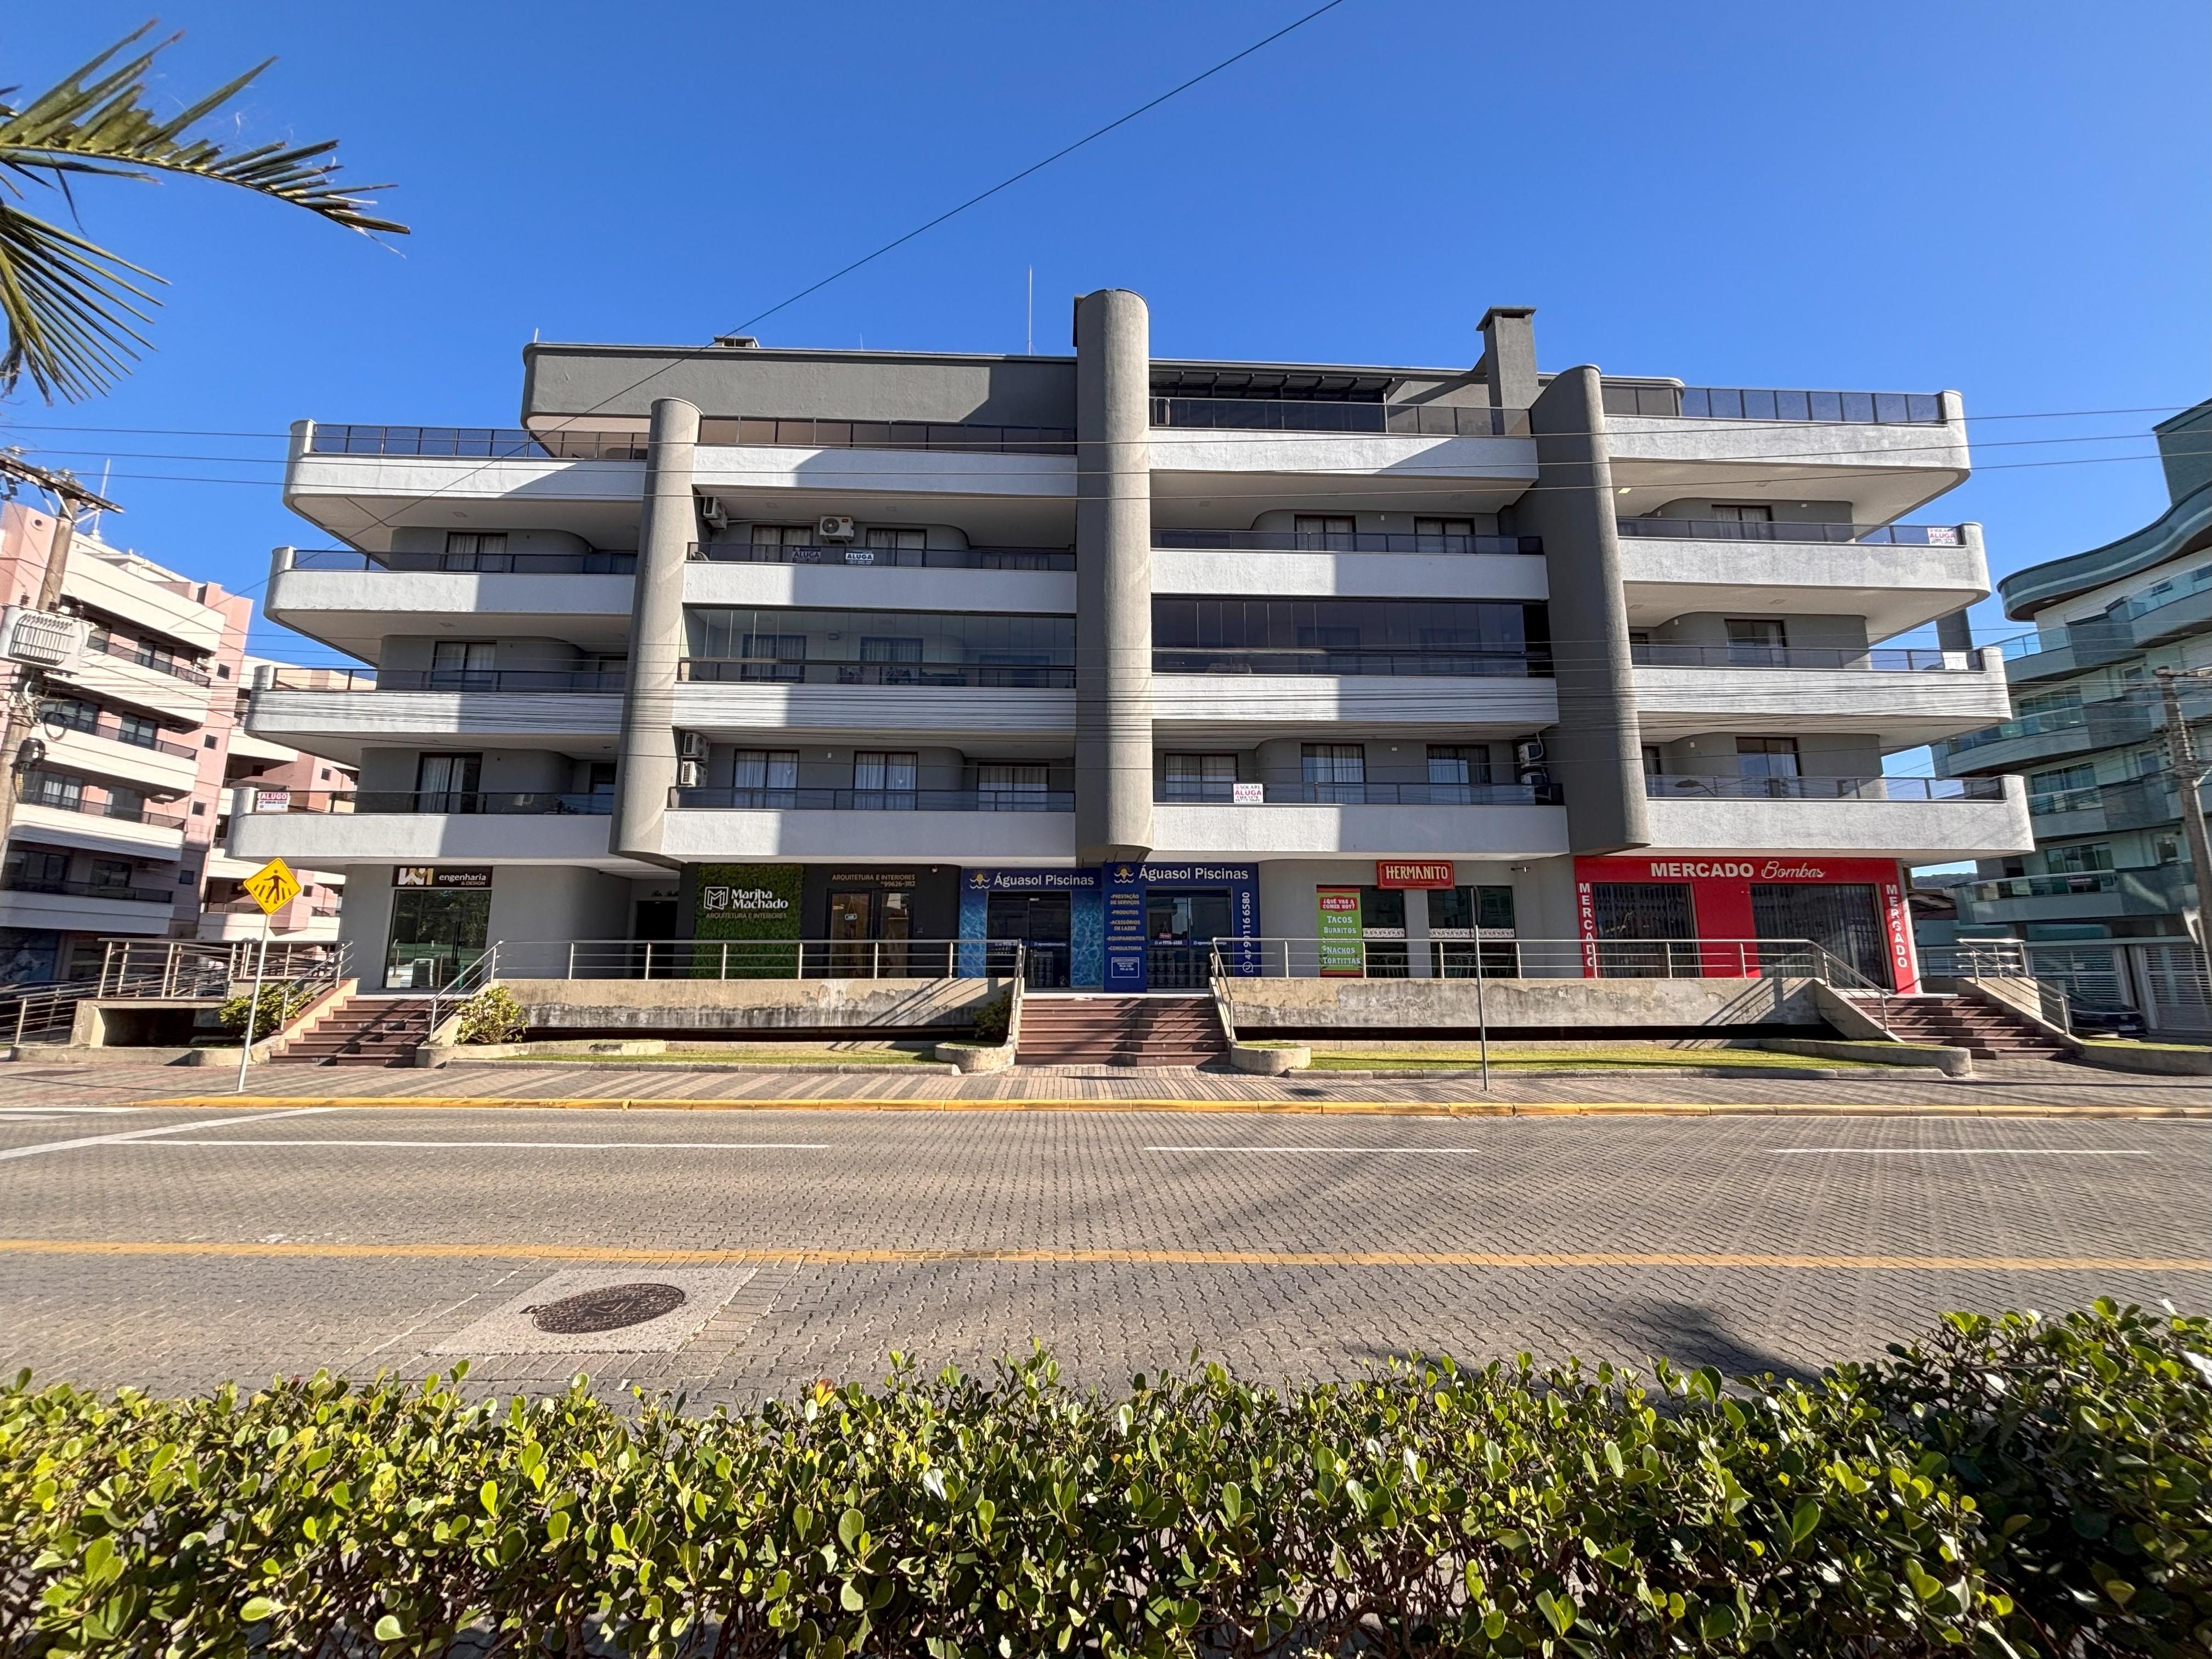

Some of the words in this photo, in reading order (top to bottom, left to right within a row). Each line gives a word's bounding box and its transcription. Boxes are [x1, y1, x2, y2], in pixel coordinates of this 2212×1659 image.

[1138, 864, 1190, 882] Águasol
[1195, 867, 1249, 879] Piscinas
[1385, 866, 1448, 879] HERMANITO
[1650, 862, 1754, 877] MERCADO
[1760, 861, 1825, 879] Bombas
[439, 873, 487, 882] engenharia
[994, 872, 1042, 888] Águasol
[1046, 874, 1094, 885] Piscinas
[731, 889, 772, 901] Marjha
[732, 898, 789, 909] Machado
[1327, 915, 1352, 923] TACOS
[1579, 883, 1593, 967] MERCADO
[1886, 884, 1908, 968] MERCADO
